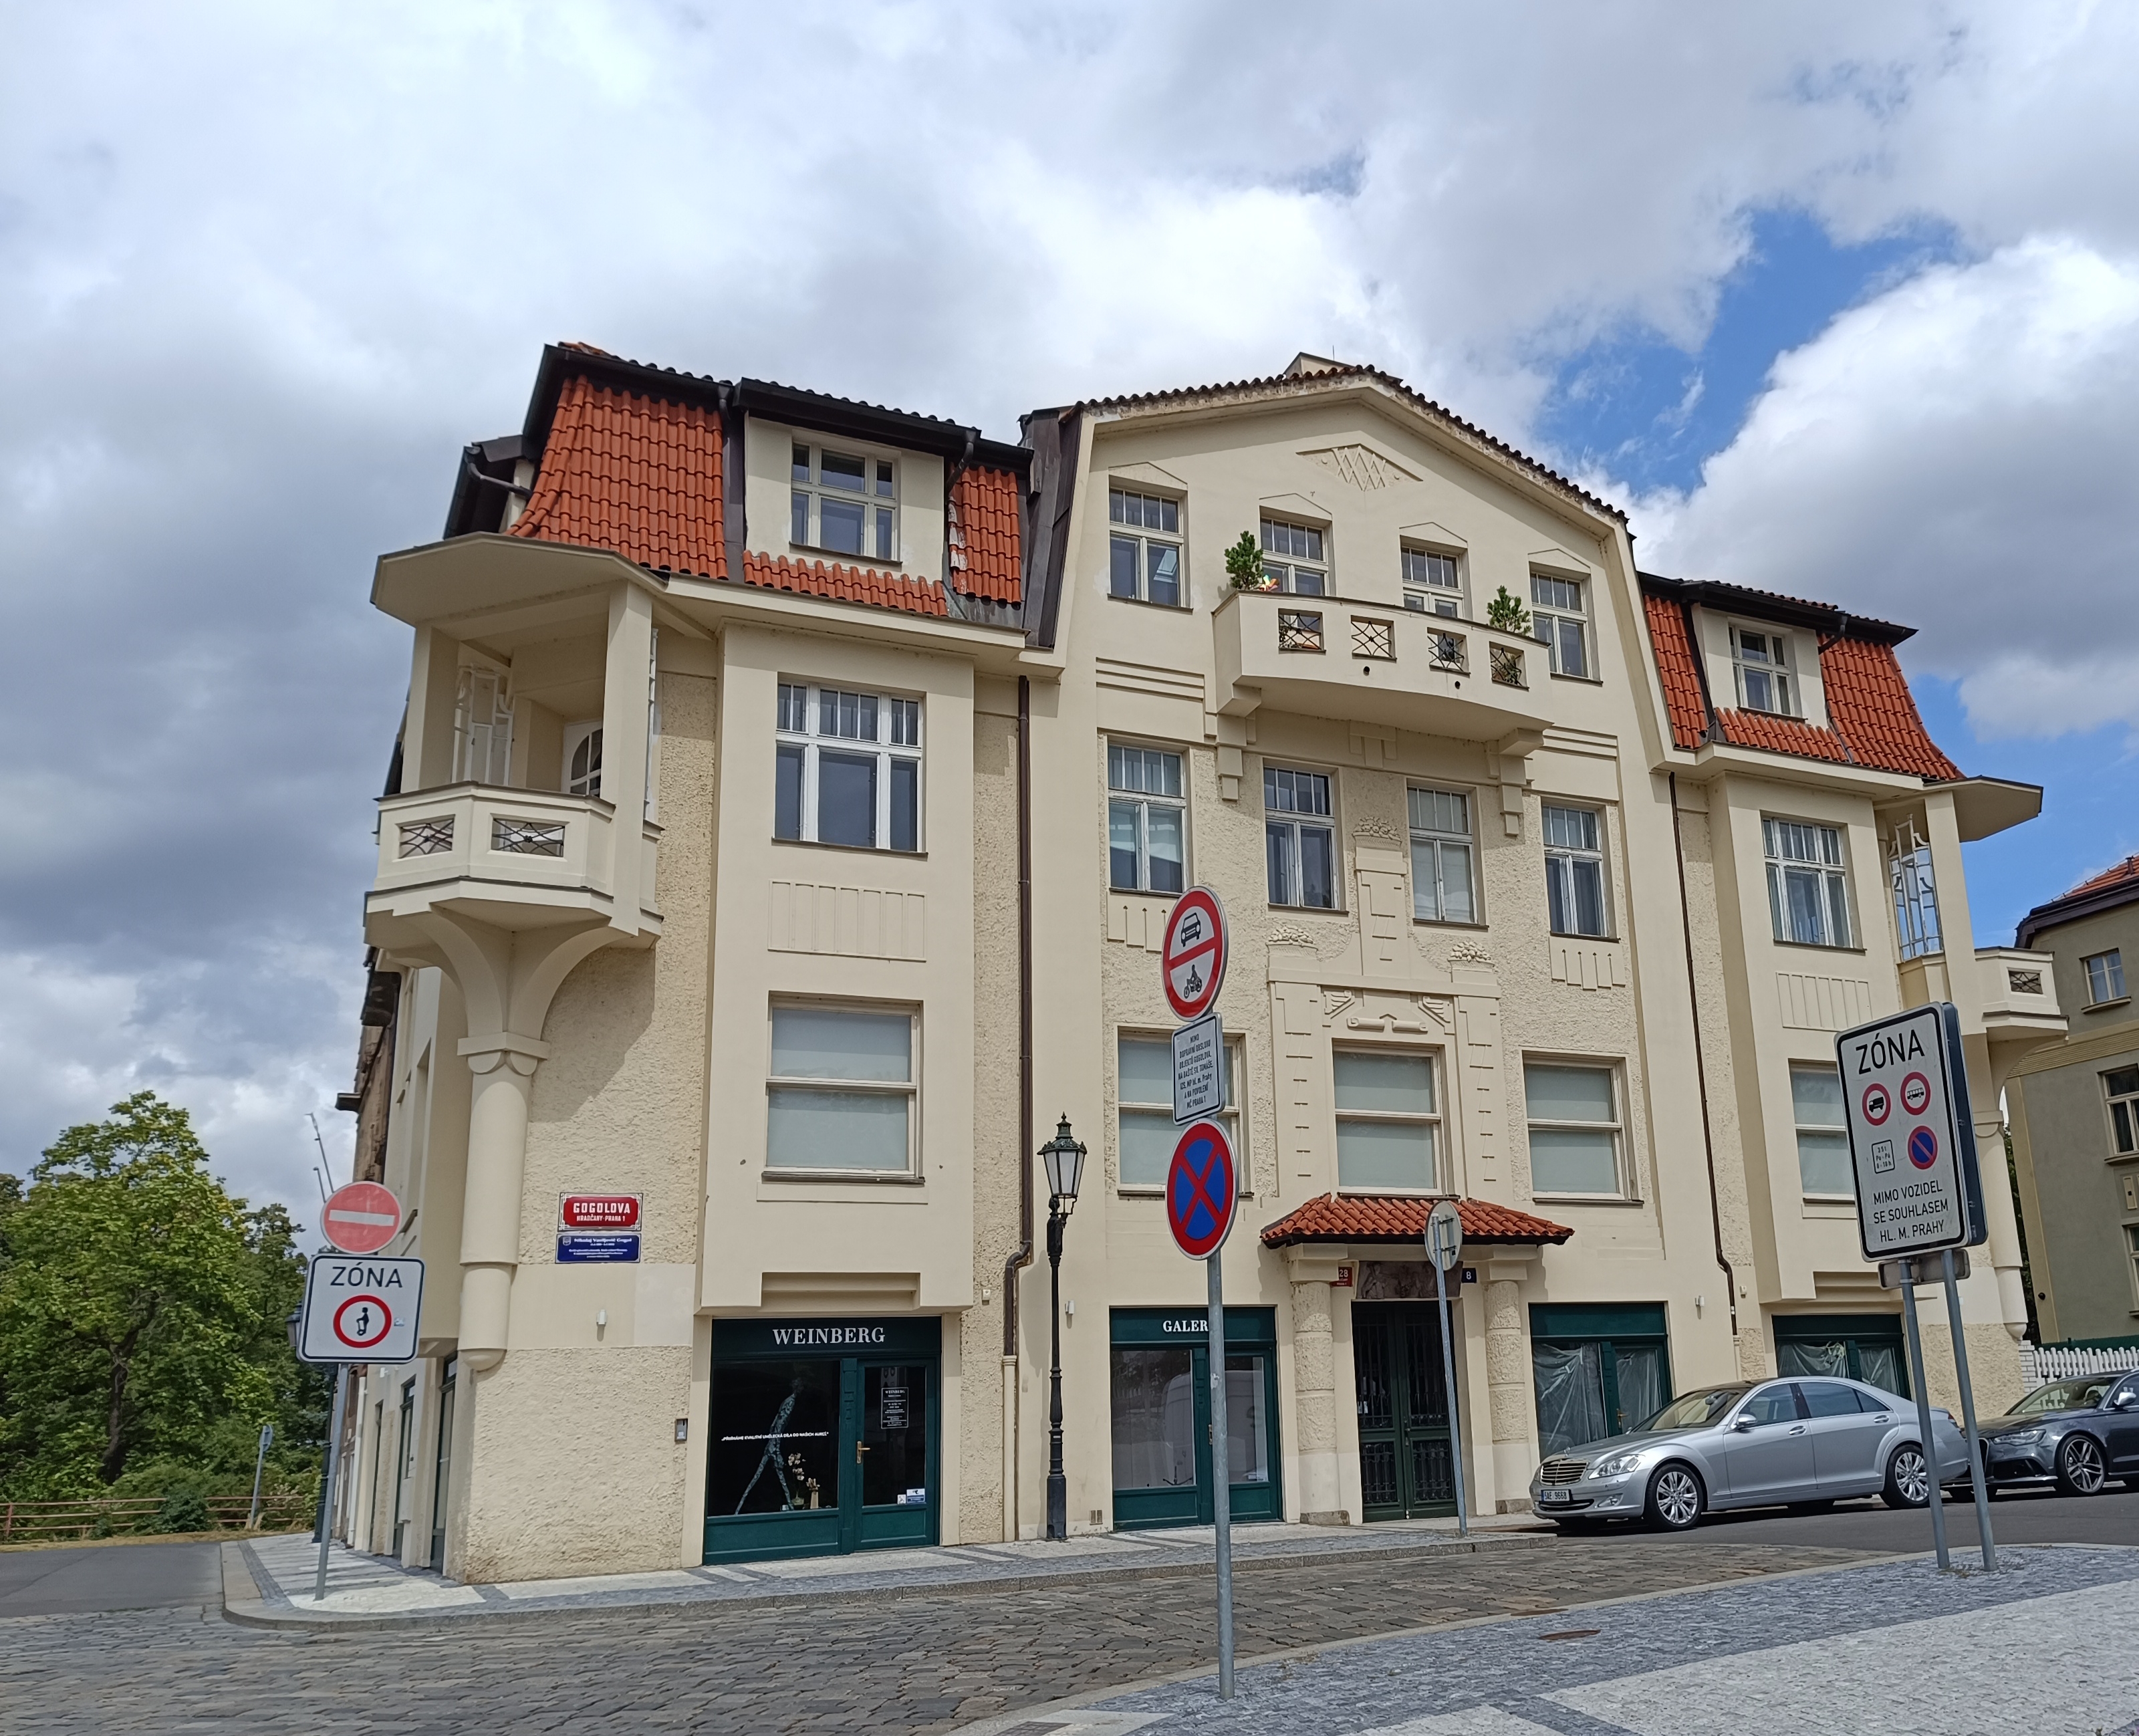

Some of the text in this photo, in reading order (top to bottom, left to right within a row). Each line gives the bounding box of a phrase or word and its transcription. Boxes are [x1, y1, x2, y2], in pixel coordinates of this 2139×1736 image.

[1190, 1033, 1199, 1043] MIMO
[1856, 1029, 1925, 1075] ZÓNA
[1873, 1179, 1943, 1205] MIMO VOZIDEL
[573, 1203, 630, 1214] GOGOLOVA
[1873, 1198, 1948, 1224] SE SOUHLASEM
[1880, 1219, 1944, 1243] HL. M. PRAHY
[330, 1261, 403, 1288] ZÓNA
[1339, 1269, 1349, 1277] 28
[1466, 1271, 1472, 1280] 8
[1162, 1320, 1209, 1332] GALER
[772, 1327, 886, 1345] WEINBERG
